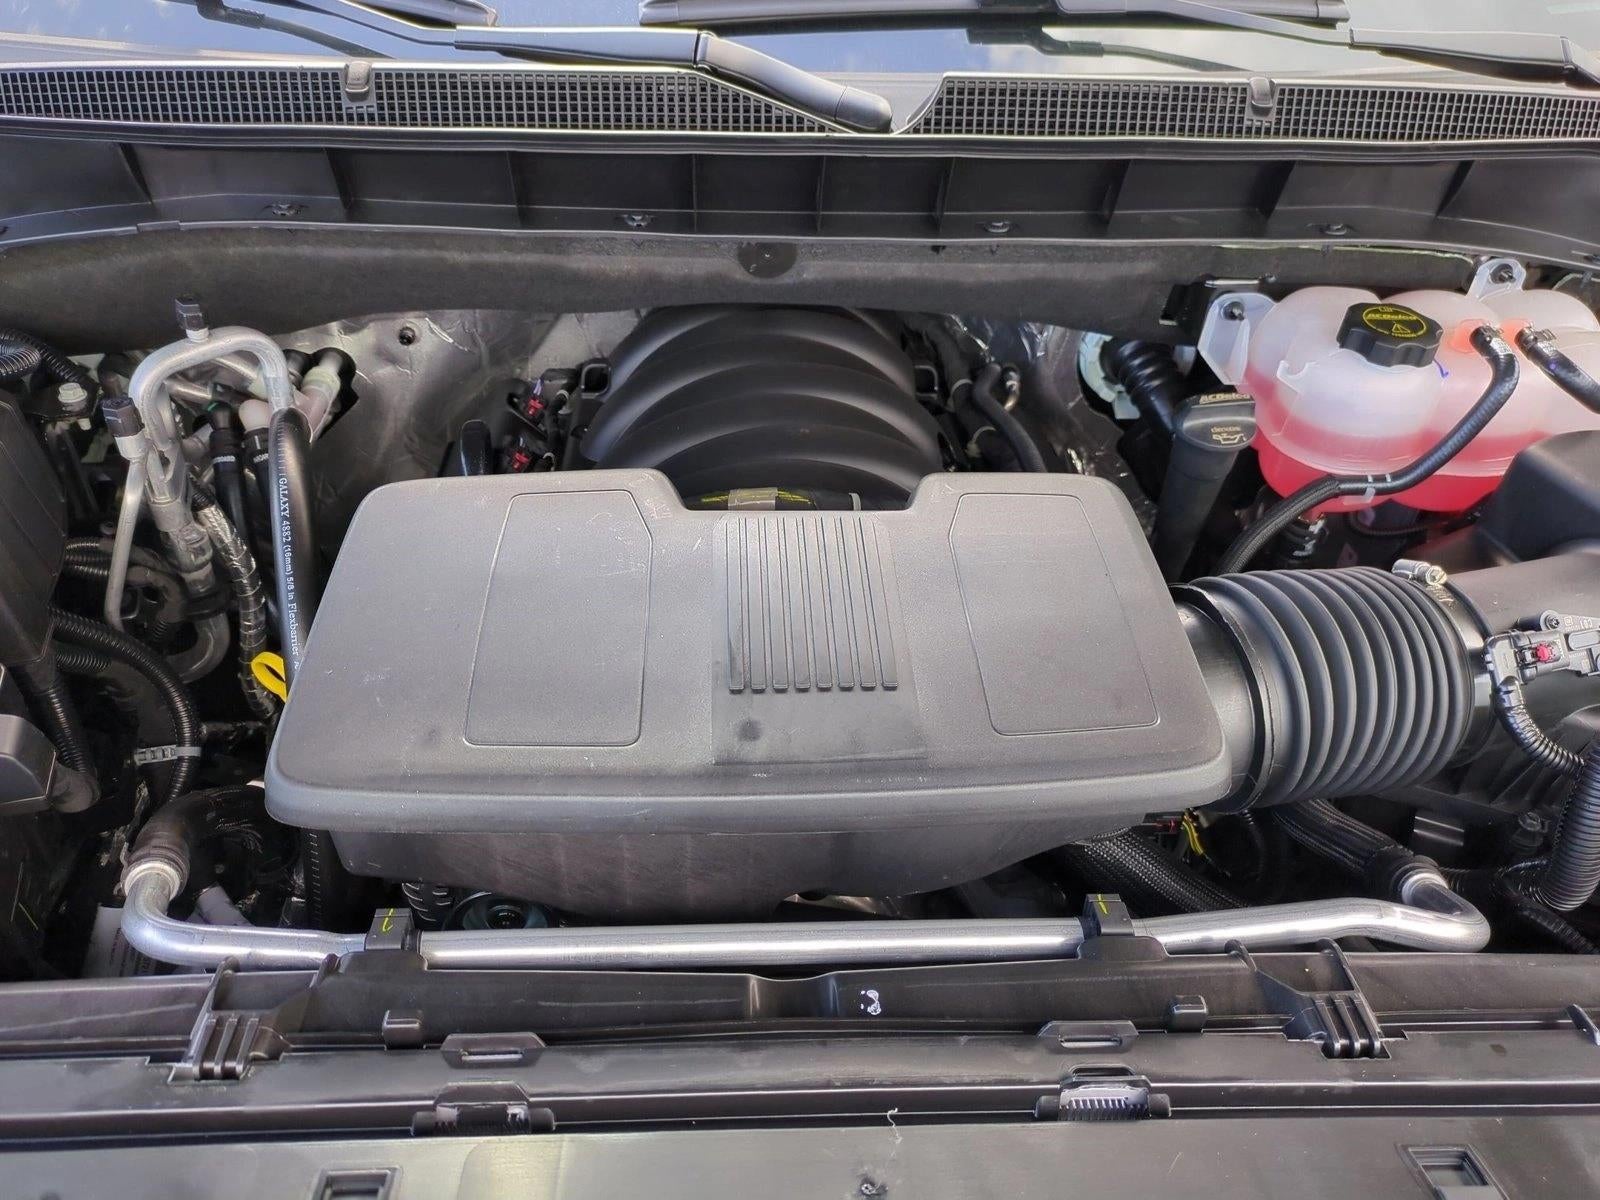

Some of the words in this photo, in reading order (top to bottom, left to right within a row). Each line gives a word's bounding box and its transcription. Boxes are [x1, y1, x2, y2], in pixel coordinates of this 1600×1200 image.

[279, 477, 290, 517] GALAXY
[282, 519, 292, 543] 4882
[283, 544, 294, 575] (16mm)
[286, 576, 295, 591] 5/8
[288, 602, 300, 656] Flexbarrier
